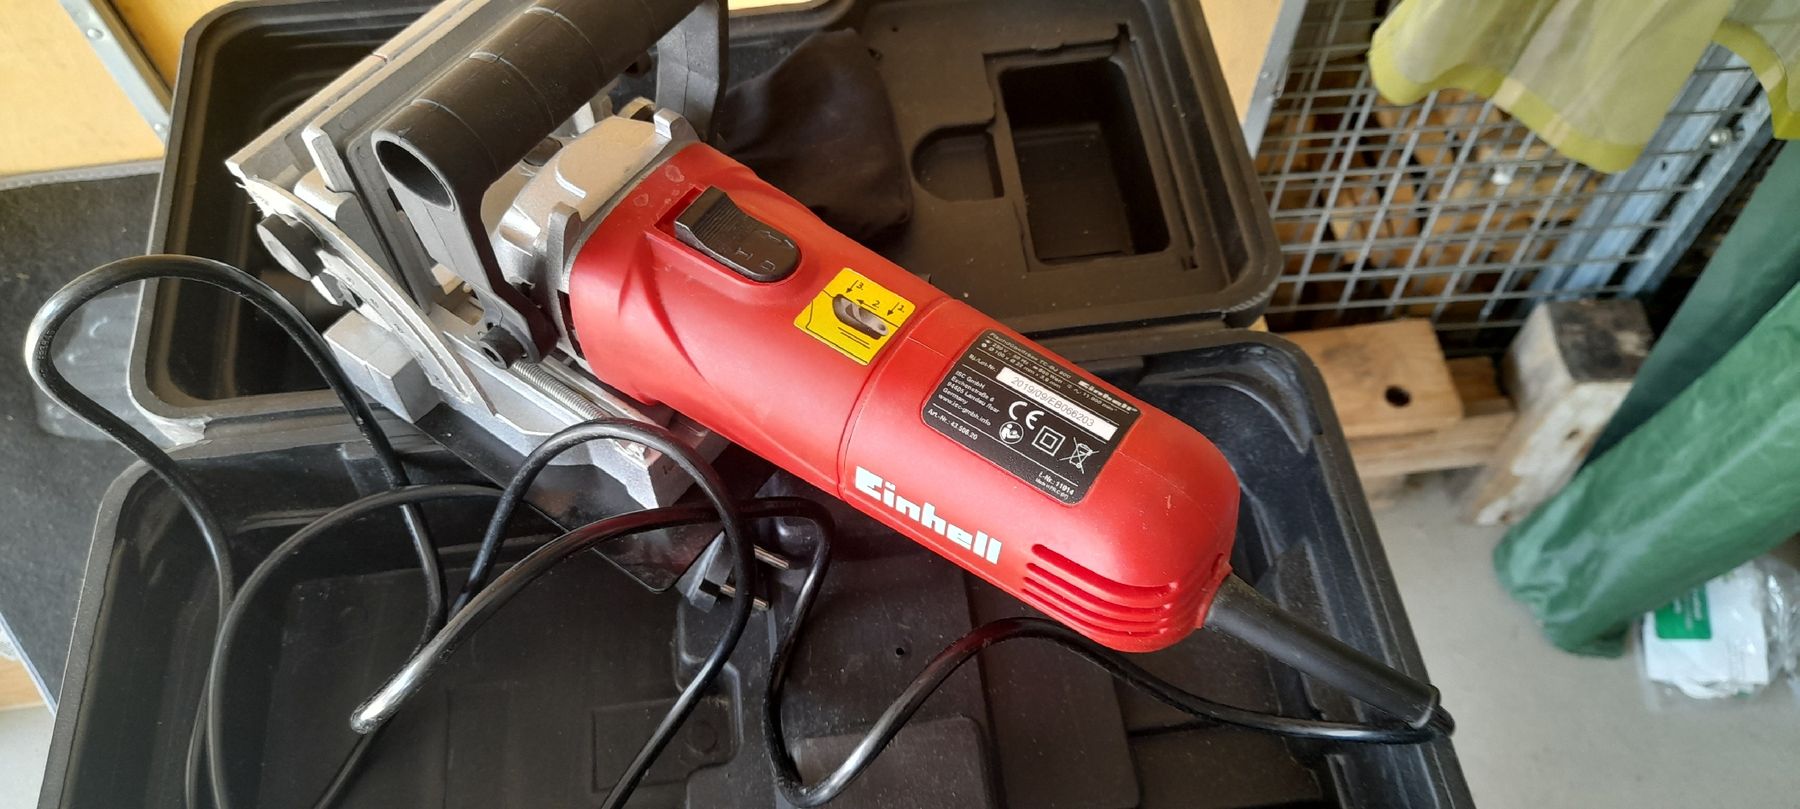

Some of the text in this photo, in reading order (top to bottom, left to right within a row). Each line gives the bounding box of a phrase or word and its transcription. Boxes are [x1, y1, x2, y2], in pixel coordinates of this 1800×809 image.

[955, 370, 984, 388] ISC GmbH
[942, 387, 968, 404] Germany
[947, 381, 964, 393] 94405
[964, 391, 986, 405] Landau
[1010, 375, 1095, 427] 2019/09/EB066203
[855, 465, 1002, 565] Einhell
